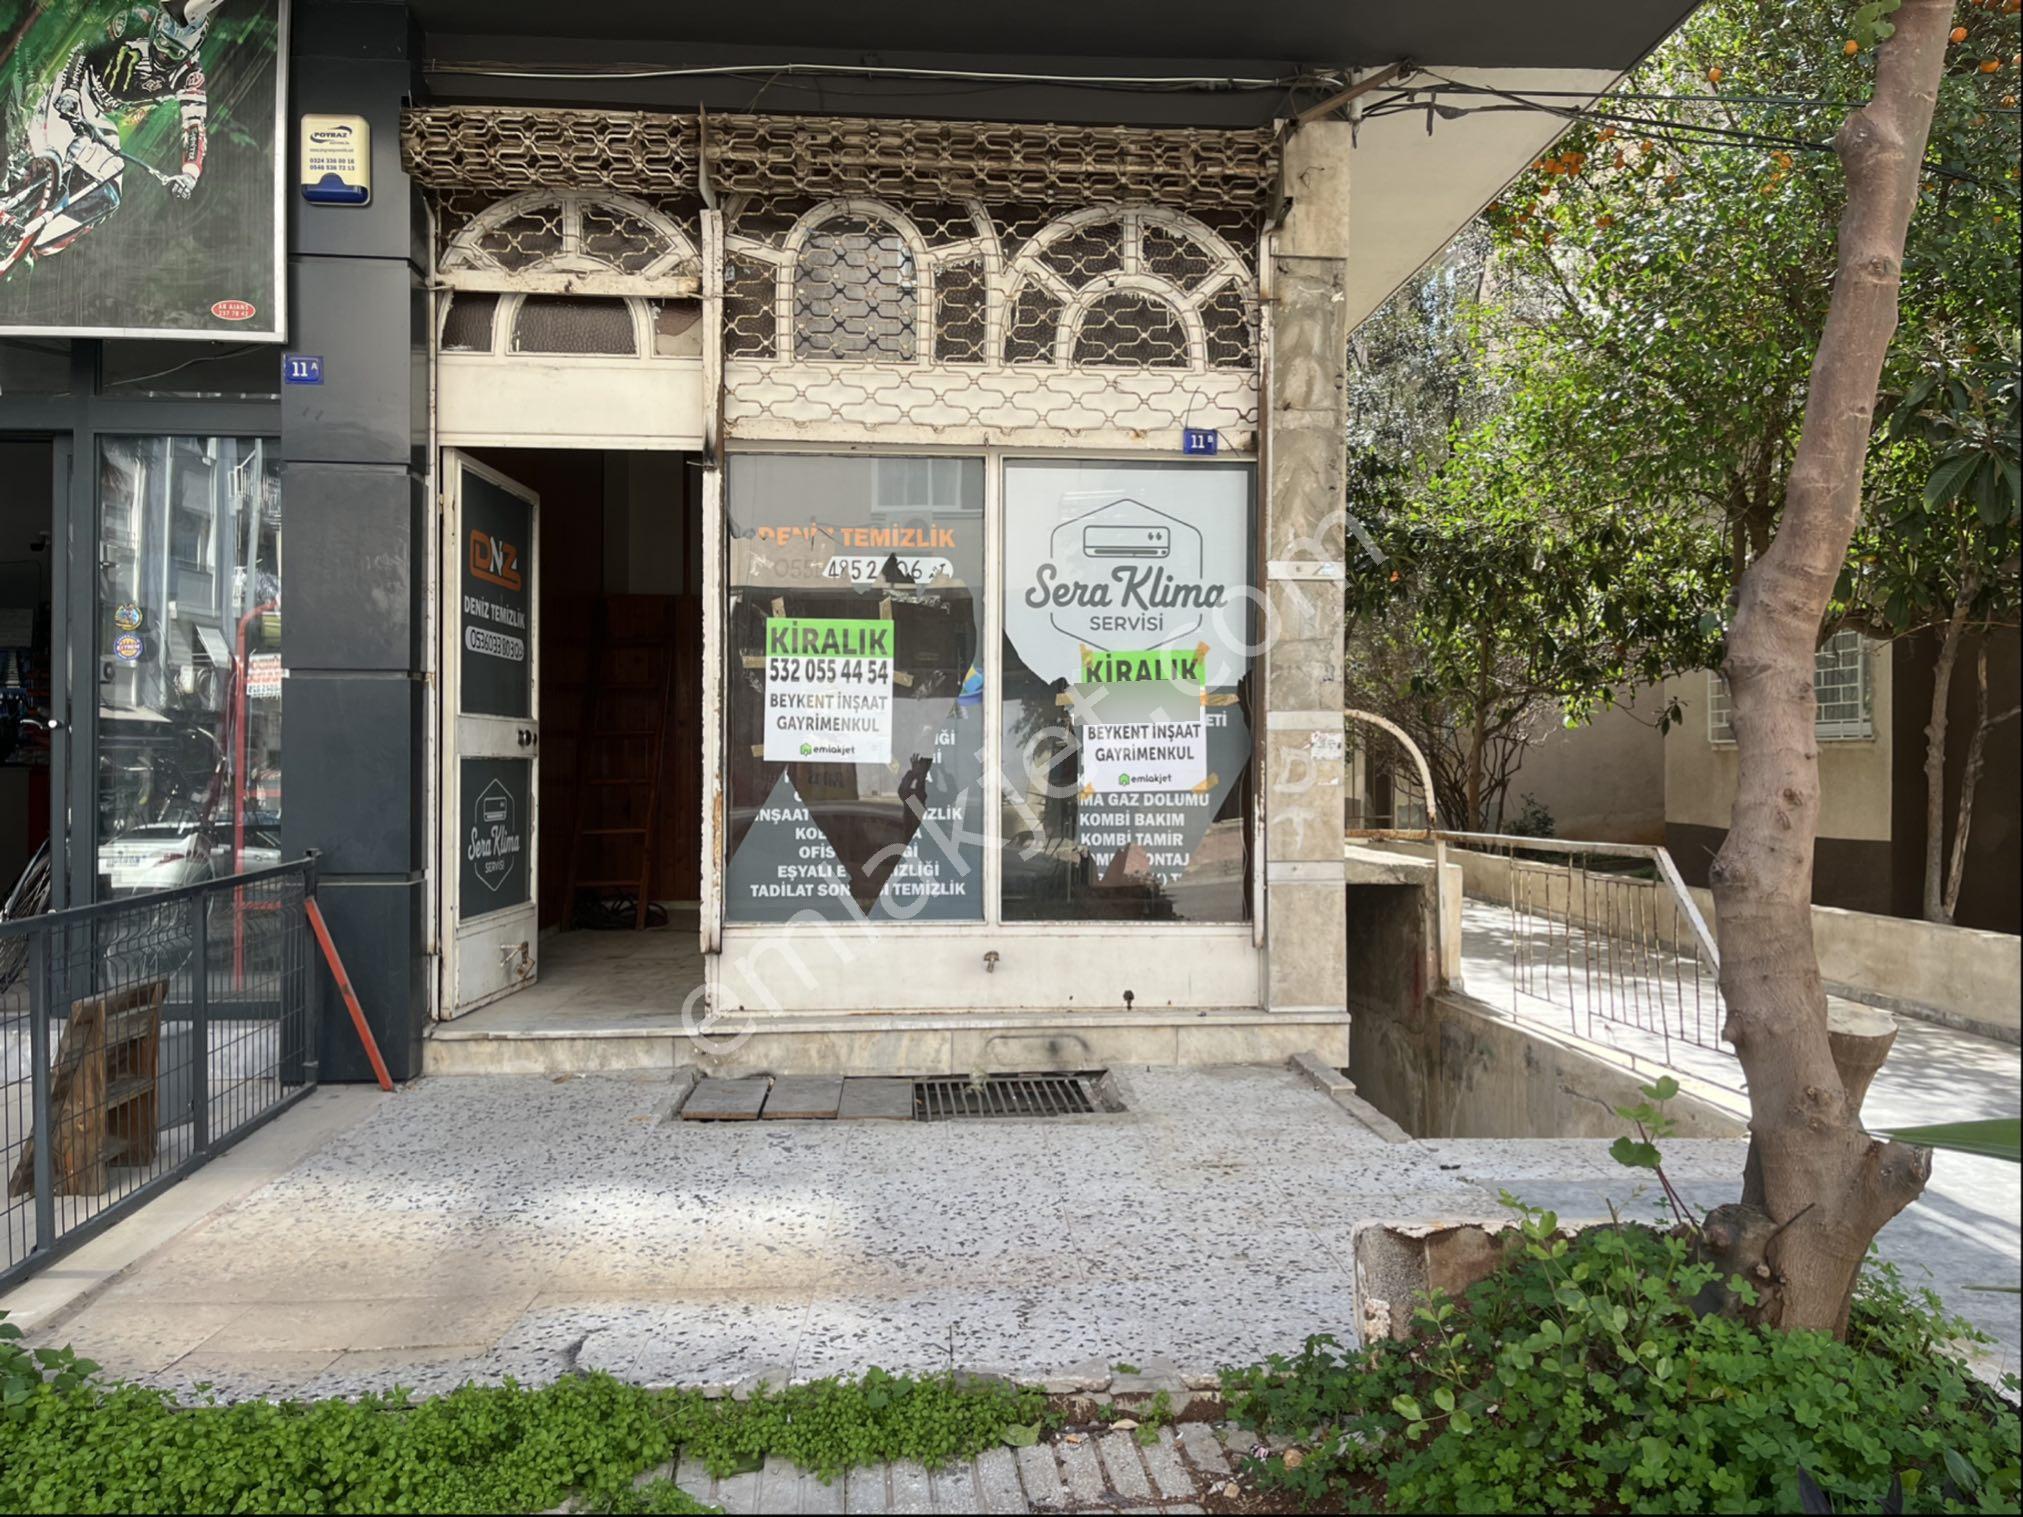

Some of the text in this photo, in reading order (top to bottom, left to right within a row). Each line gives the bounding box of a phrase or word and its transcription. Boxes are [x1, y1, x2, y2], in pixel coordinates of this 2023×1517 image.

[292, 361, 318, 377] 11 A
[1191, 434, 1205, 449] 11
[840, 523, 956, 548] TEMİZLİK
[1025, 563, 1228, 612] Sera Klima
[464, 594, 526, 629] DENİZ TEMİZLİK
[1089, 612, 1164, 631] SERVİSİ
[770, 620, 888, 655] KİRALIK
[769, 657, 888, 685] 532 055 44 54
[1086, 653, 1199, 684] KİRALIK
[770, 691, 888, 712] BEYKENT İNŞAAT
[776, 713, 880, 733] GAYRİMENKUL
[1088, 722, 1201, 743] BEYKENT İNŞAAT
[813, 746, 856, 756] emlakjet
[1095, 743, 1195, 762] GAYRİMENKUL
[1131, 773, 1172, 785] emlakjet
[1108, 793, 1139, 807] GAZ
[1143, 793, 1210, 807] DOLUMU
[1079, 810, 1185, 827] KOMBİ BAKIM
[467, 824, 520, 861] Sera Klima
[1080, 829, 1184, 847] KOMBİ TAMİR
[798, 843, 836, 859] OFİS
[777, 864, 832, 882] EŞYALI
[750, 880, 814, 897] TADİLAT
[892, 879, 966, 897] TEMİZLİK
